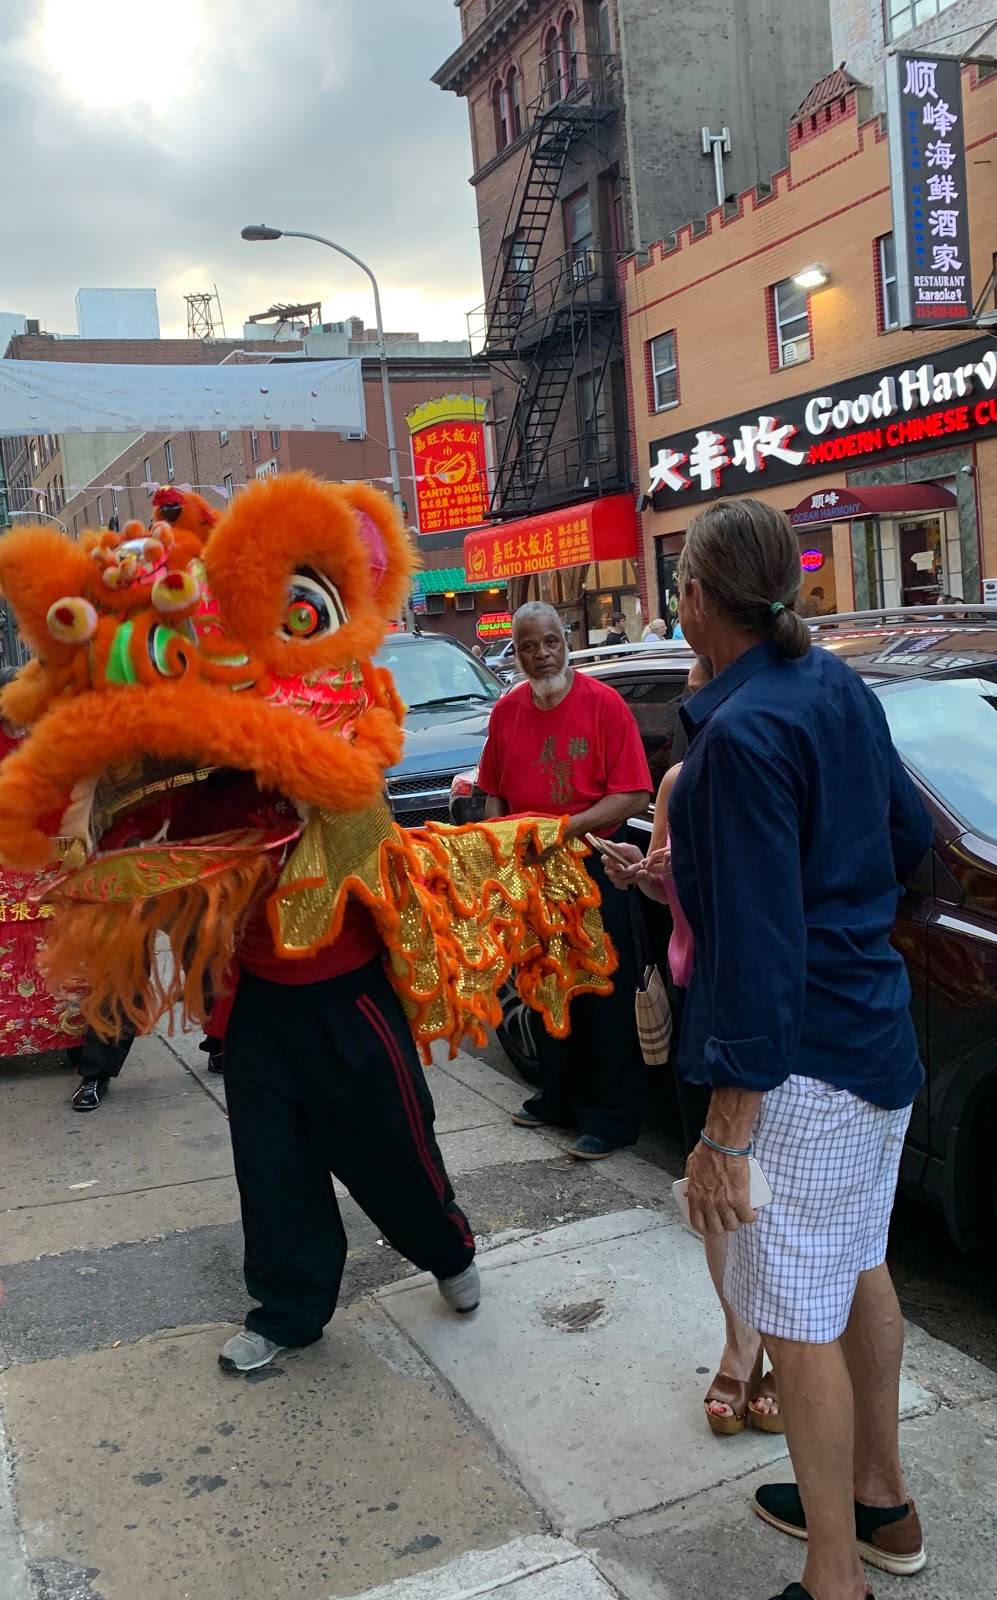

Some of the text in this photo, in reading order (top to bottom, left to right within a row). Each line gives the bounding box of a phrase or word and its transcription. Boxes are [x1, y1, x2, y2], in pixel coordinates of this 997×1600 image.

[903, 60, 962, 272] 顺峰海鲜酒家
[914, 276, 965, 286] RESTAURANT
[918, 288, 956, 300] karaoke
[805, 351, 997, 435] Good Harv
[807, 429, 883, 464] MODERN
[886, 405, 969, 446] CHINESE
[648, 416, 807, 493] 大丰收
[420, 487, 451, 499] CANTO
[793, 503, 861, 523] OCEAN HARMONY
[492, 528, 553, 566] 嘉旺大飯店
[492, 561, 521, 577] CANTO
[525, 554, 556, 572] HOUSE
